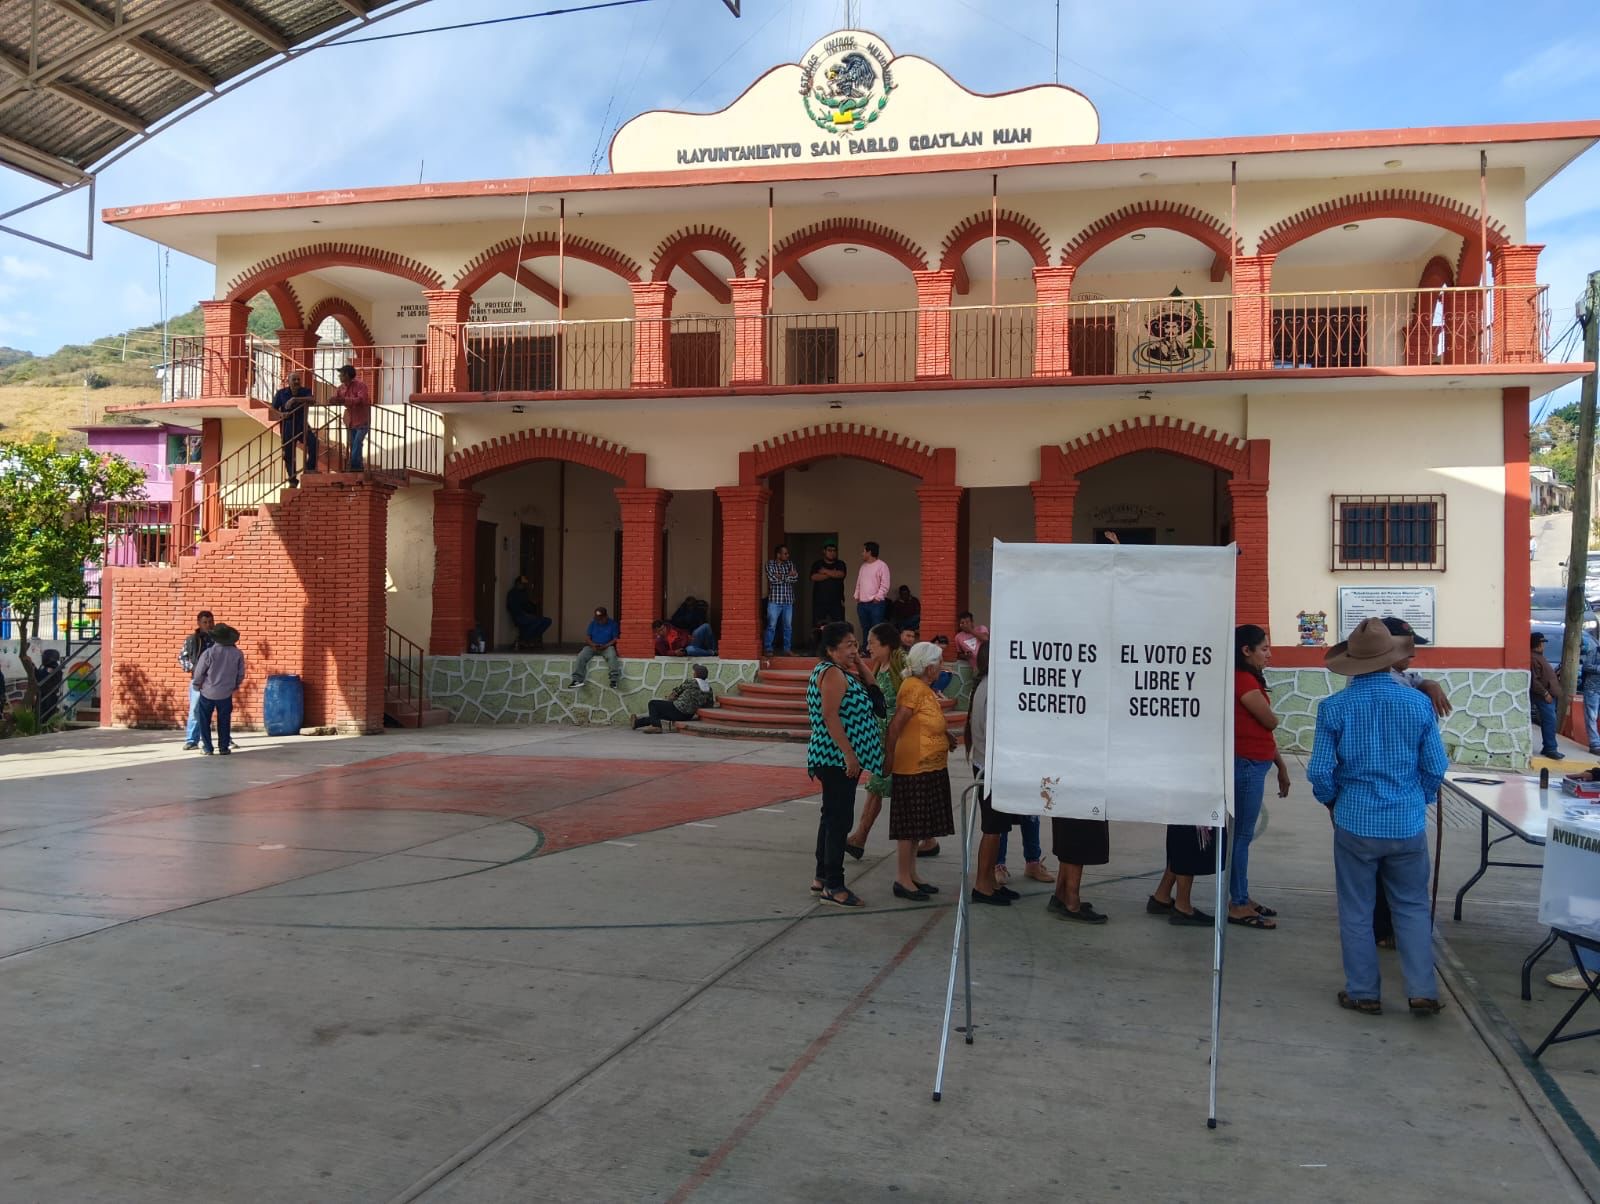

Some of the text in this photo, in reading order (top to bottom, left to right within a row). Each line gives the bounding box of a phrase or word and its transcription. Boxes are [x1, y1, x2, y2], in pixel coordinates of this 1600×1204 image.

[811, 139, 841, 156] SAN
[849, 136, 899, 154] PABLO
[1009, 640, 1097, 663] EL VOTO ES
[1120, 645, 1212, 665] EL VOTO ES
[1023, 667, 1082, 688] LIBRE Y
[1134, 671, 1196, 691] LIBRE Y
[1018, 692, 1086, 715] SECRETO
[1129, 697, 1200, 718] SECRETO
